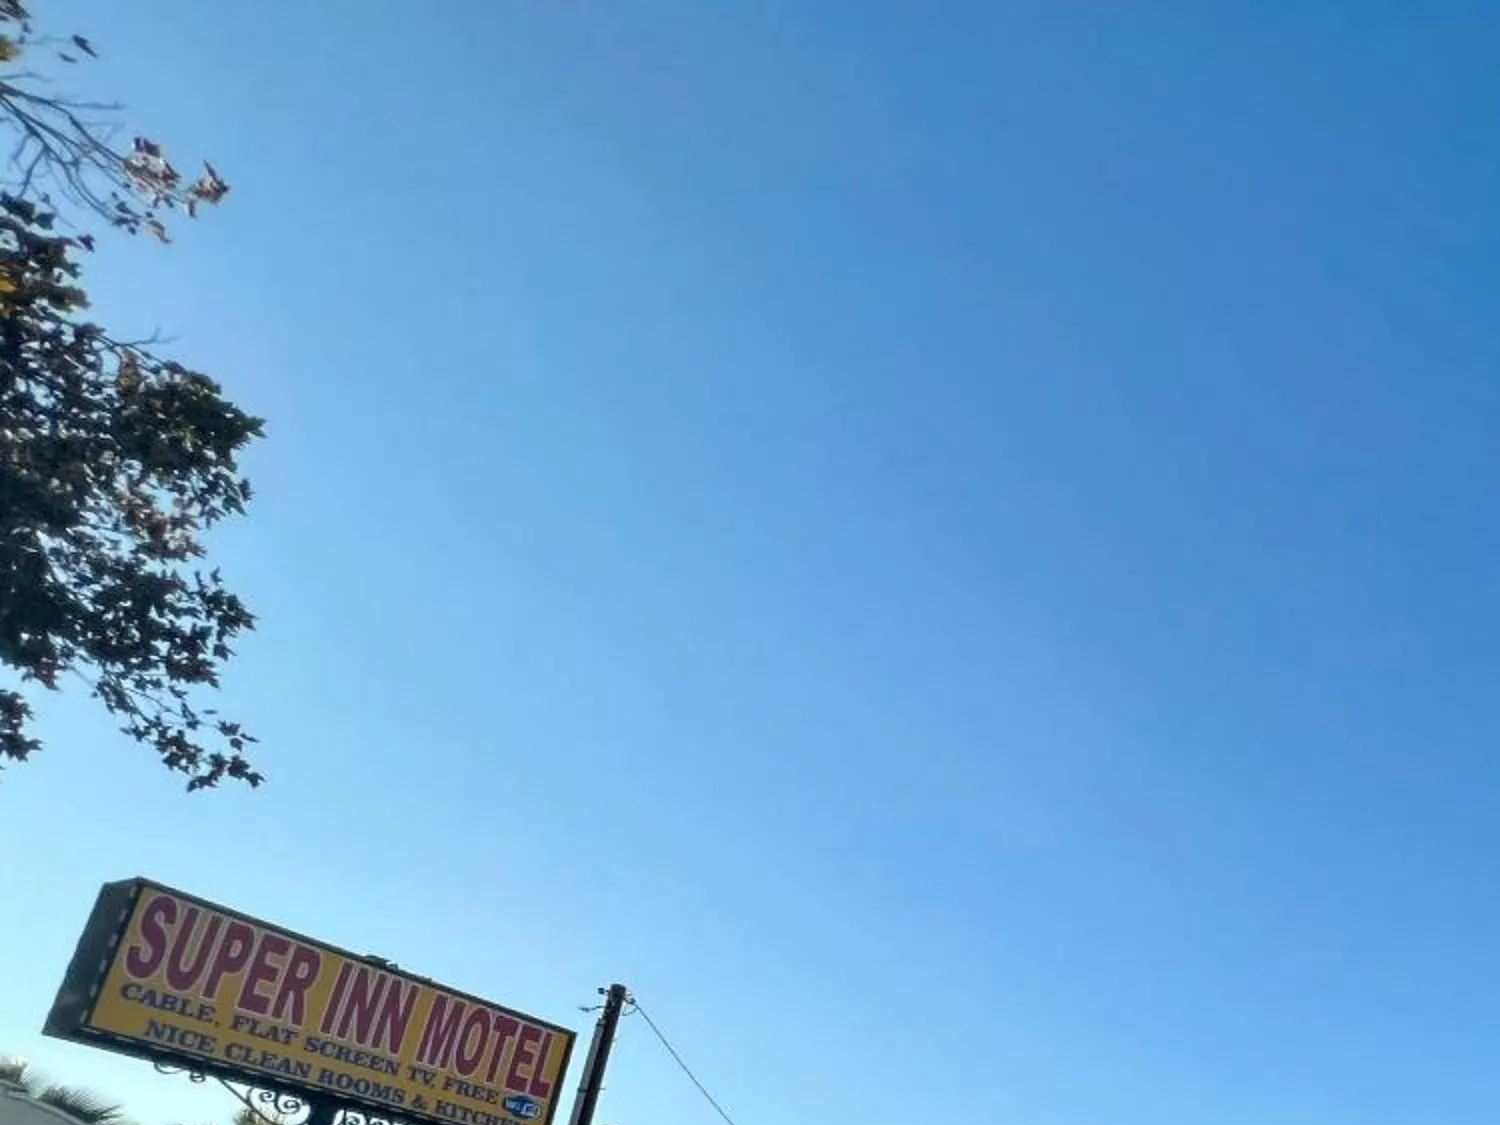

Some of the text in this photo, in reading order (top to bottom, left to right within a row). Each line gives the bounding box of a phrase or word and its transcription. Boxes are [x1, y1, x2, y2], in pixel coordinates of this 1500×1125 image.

[126, 894, 553, 1098] SUPER INN MOTEL
[143, 1019, 218, 1053] NICE
[224, 1042, 312, 1079] CLEAN
[318, 1067, 406, 1104] ROOMS
[412, 1093, 426, 1110] &
[229, 1014, 300, 1046] FLAT
[303, 1035, 401, 1076] SCREEN
[442, 1075, 500, 1105] FREE
